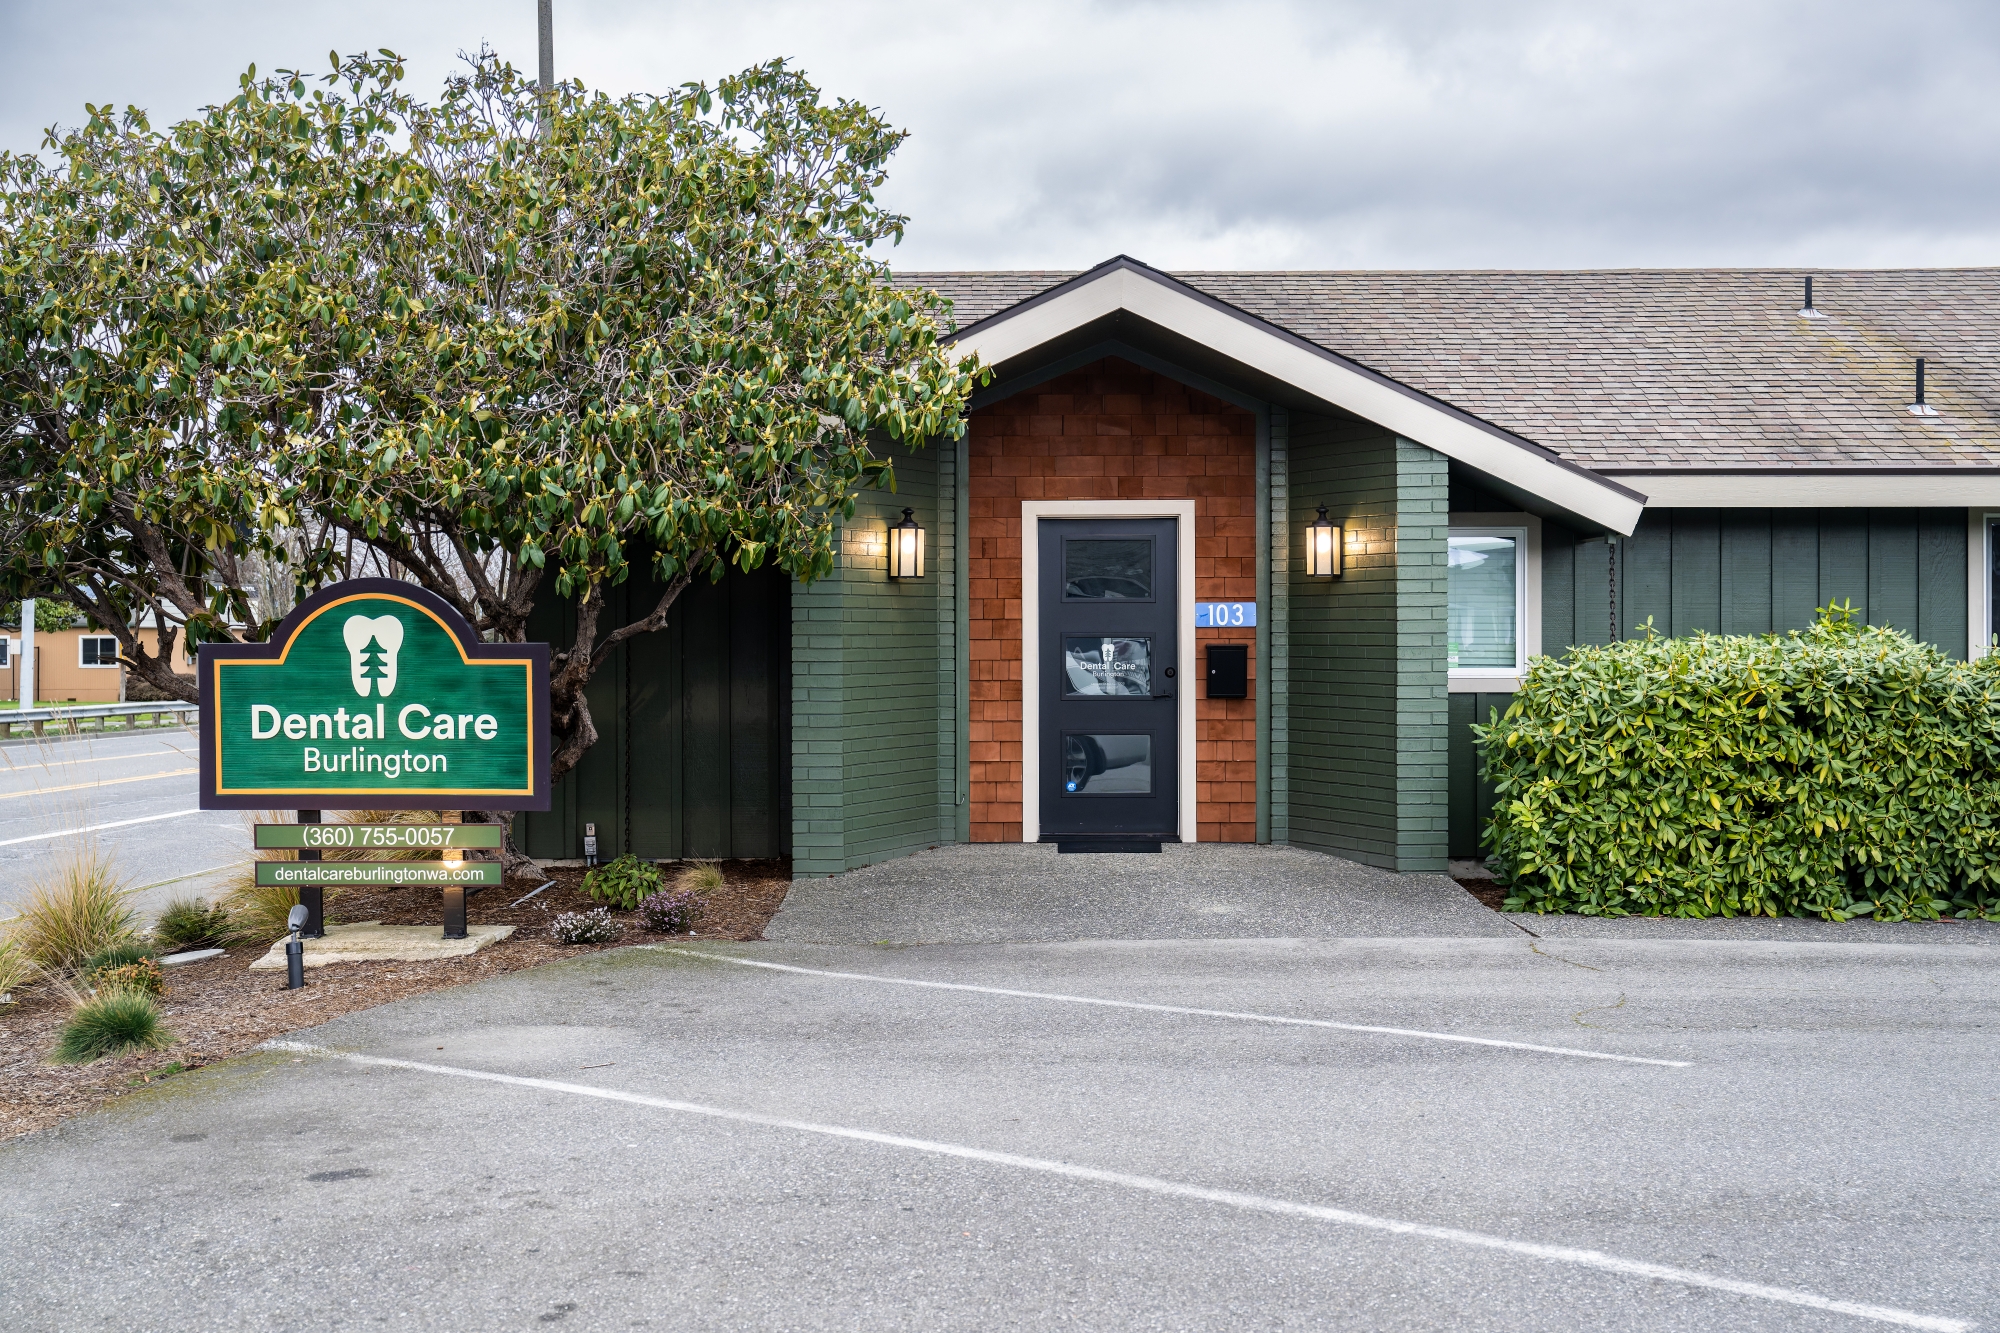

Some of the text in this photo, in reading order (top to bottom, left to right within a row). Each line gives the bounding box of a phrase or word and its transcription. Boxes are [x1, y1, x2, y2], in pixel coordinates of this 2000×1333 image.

[1207, 603, 1244, 626] 103
[1080, 661, 1136, 670] Dental Care
[1092, 670, 1125, 678] Burlington
[251, 703, 498, 740] Dental Care
[304, 746, 447, 779] Burlington
[302, 826, 455, 847] (360) 755-0057
[274, 866, 484, 883] dentalcareburlingtonwa.com
